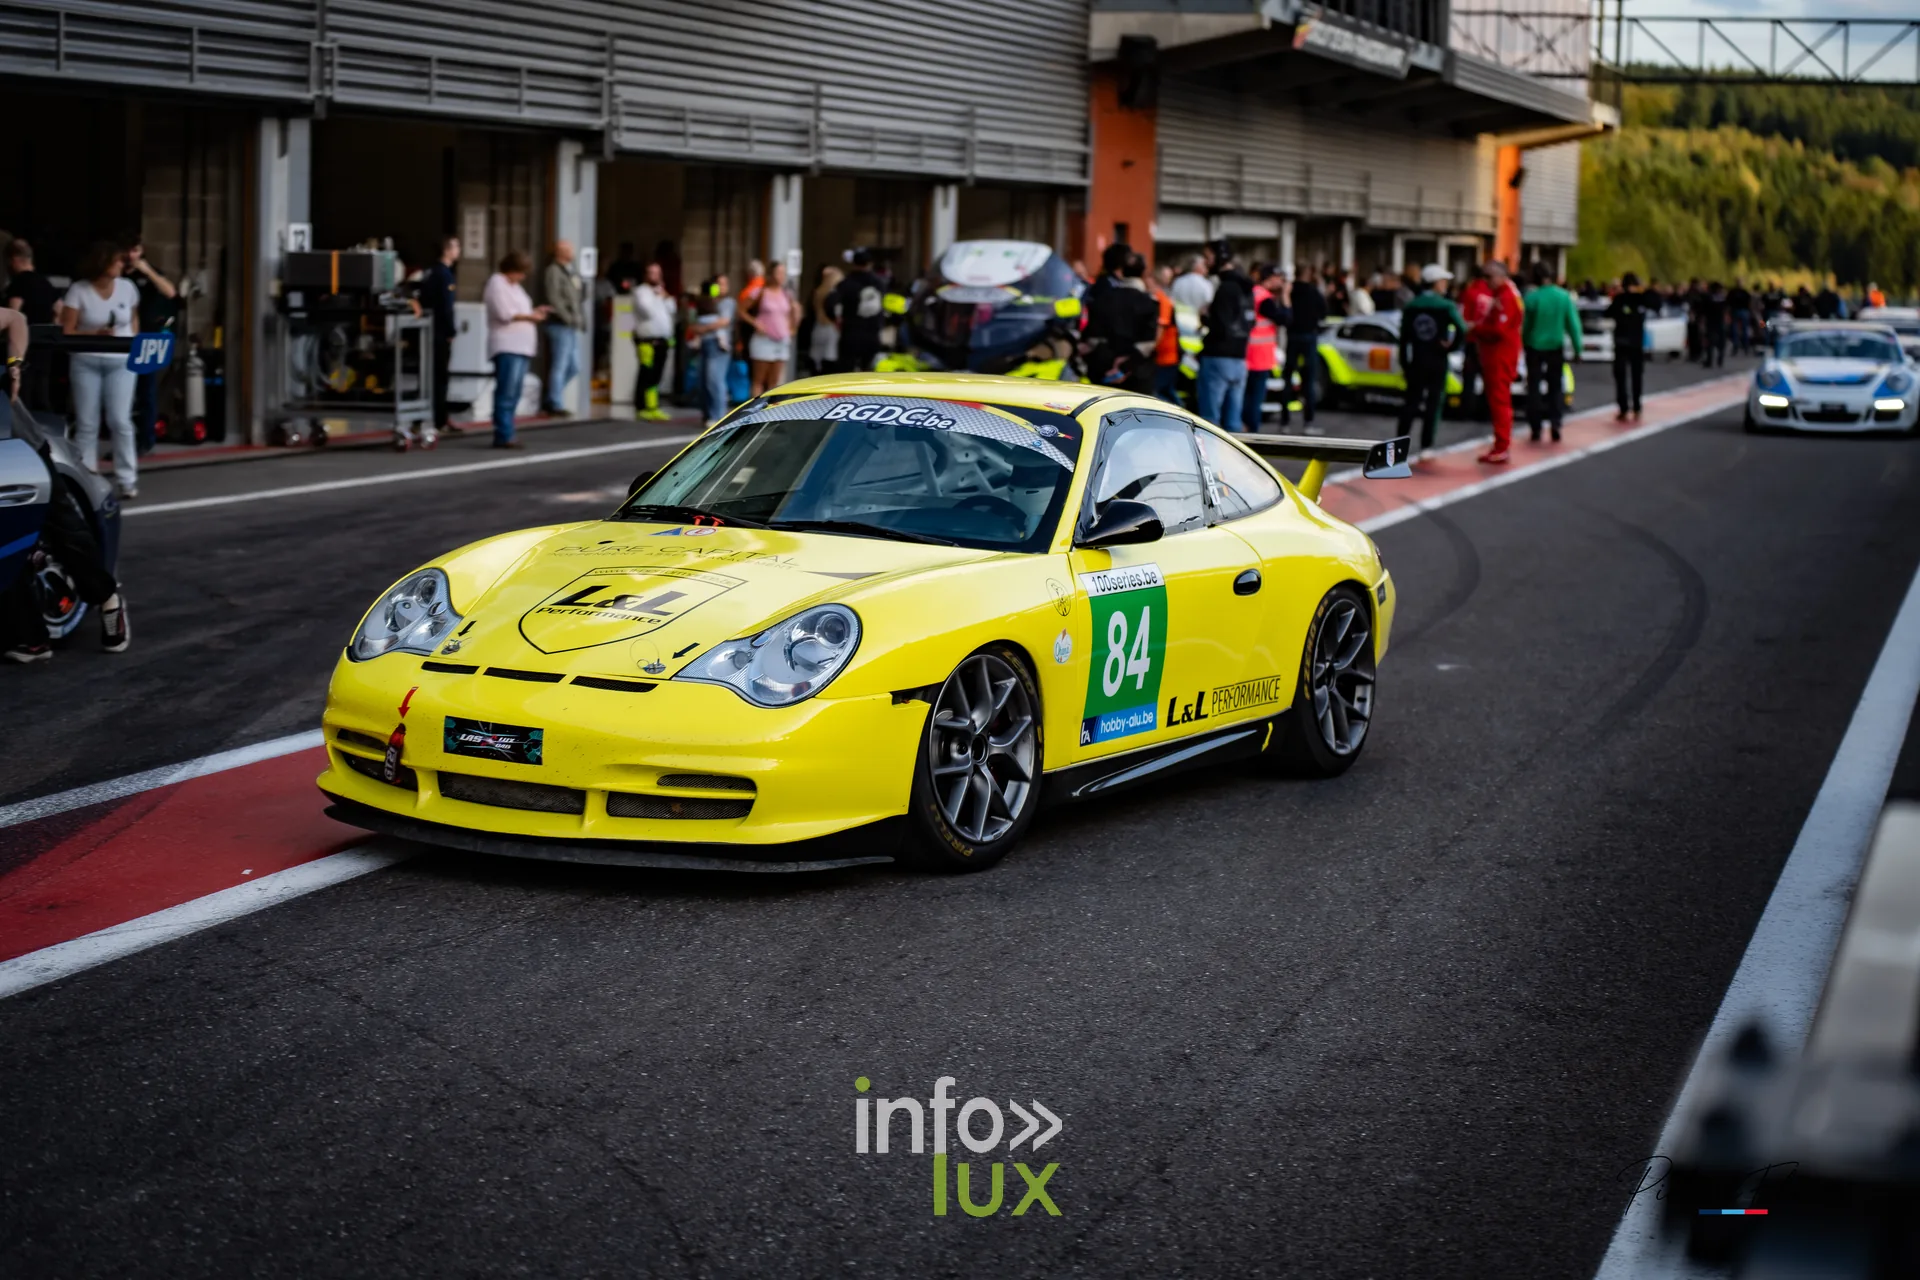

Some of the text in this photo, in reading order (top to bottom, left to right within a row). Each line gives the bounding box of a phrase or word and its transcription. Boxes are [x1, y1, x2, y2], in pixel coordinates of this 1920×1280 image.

[134, 338, 171, 365] JPV
[823, 403, 954, 429] BGDC.be
[554, 545, 800, 567] PURE CAPITAL
[1091, 568, 1158, 593] 100series.be
[550, 585, 688, 617] L&L
[536, 607, 662, 624] Performance
[1103, 605, 1151, 698] 84
[1166, 678, 1281, 727] L&L PERFORMANCE
[1099, 710, 1154, 735] hobby-alu.be
